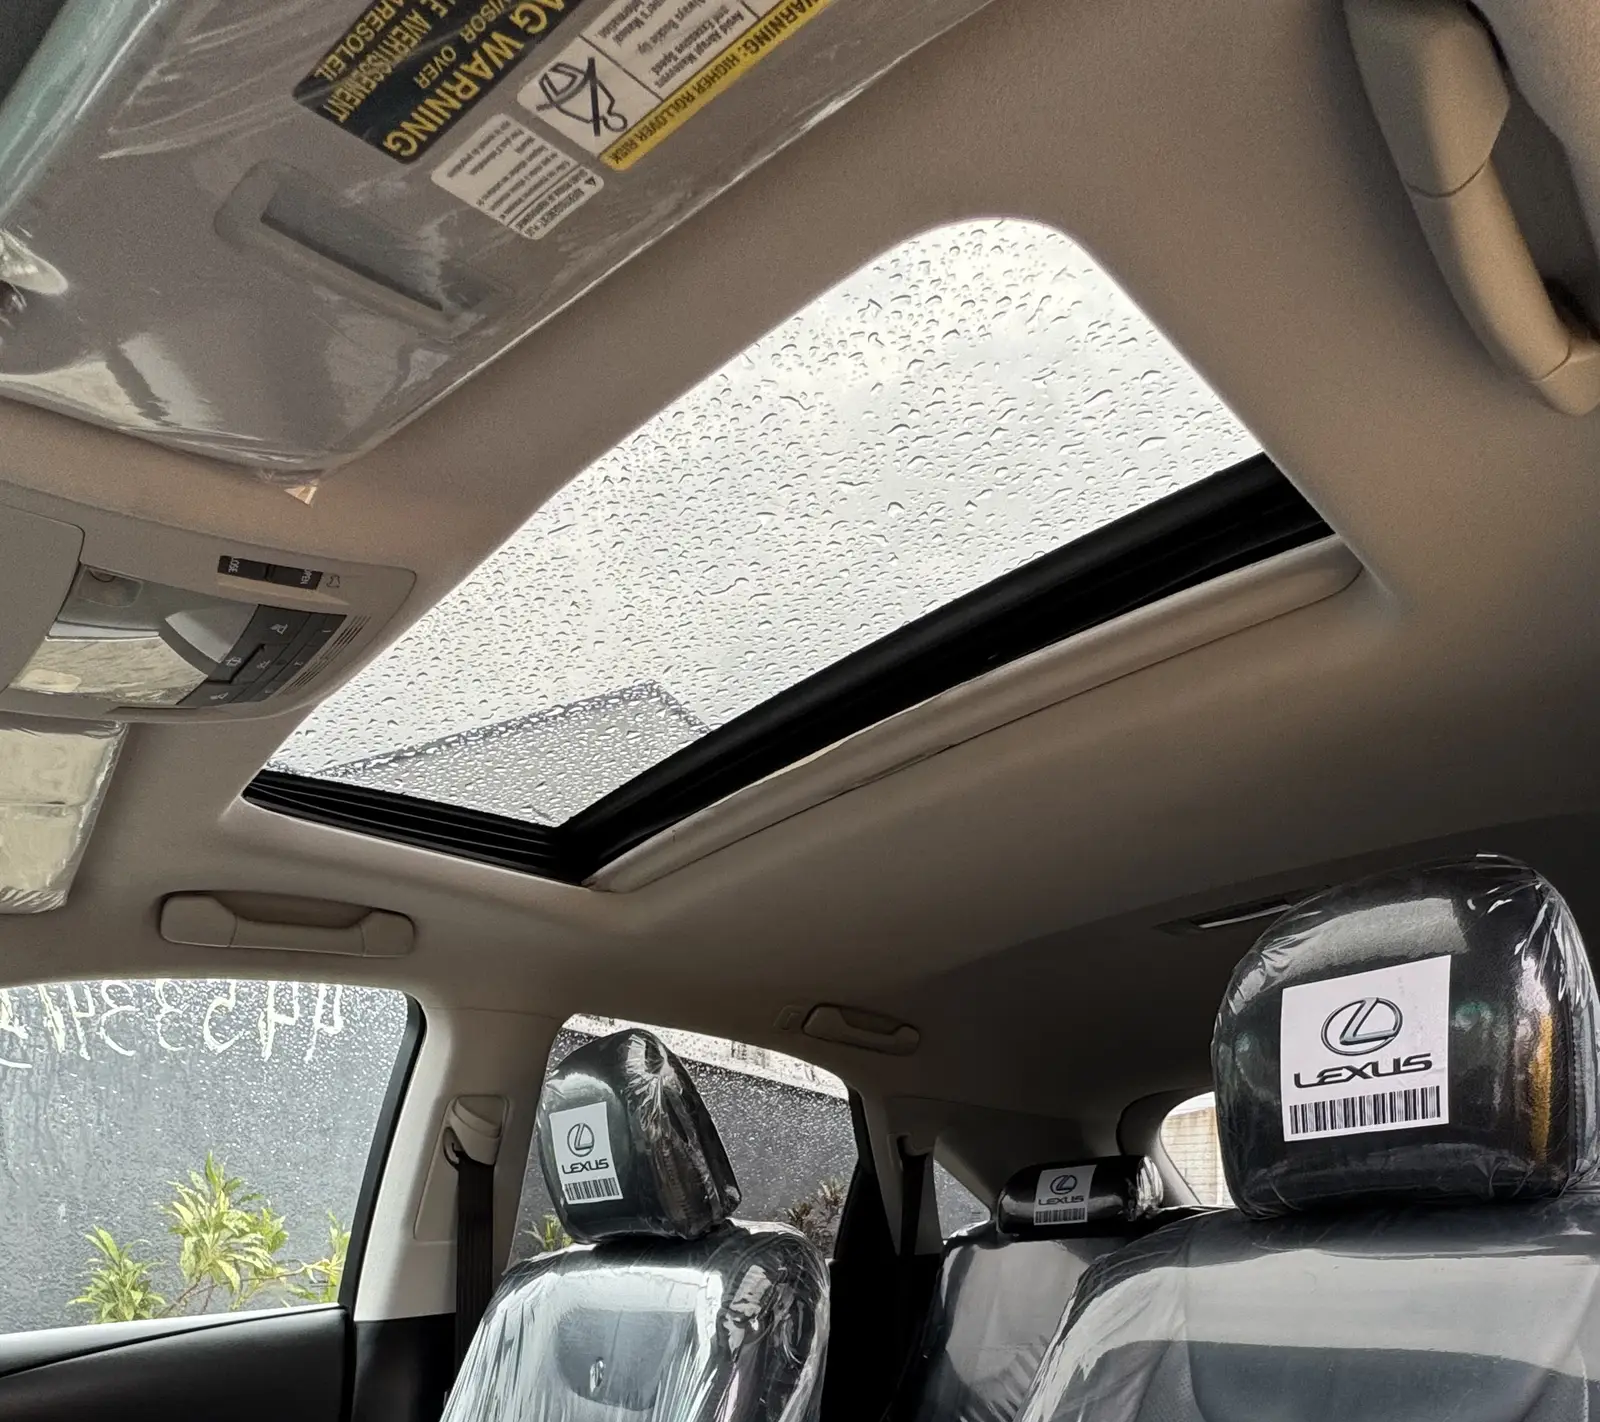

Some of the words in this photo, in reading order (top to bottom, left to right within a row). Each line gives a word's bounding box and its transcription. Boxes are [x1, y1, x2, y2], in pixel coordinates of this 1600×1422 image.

[313, 0, 404, 82] RESOLEIL
[322, 8, 432, 123] AVERTISSEMENT
[413, 45, 457, 89] OVER
[694, 54, 742, 94] HIGHER
[383, 31, 525, 157] WARNING
[637, 91, 696, 143] ROLLOVER
[609, 138, 639, 165] RISK
[1293, 1052, 1433, 1089] LEXUS
[561, 1158, 610, 1175] LEXUS
[1038, 1195, 1085, 1206] LEXUS
